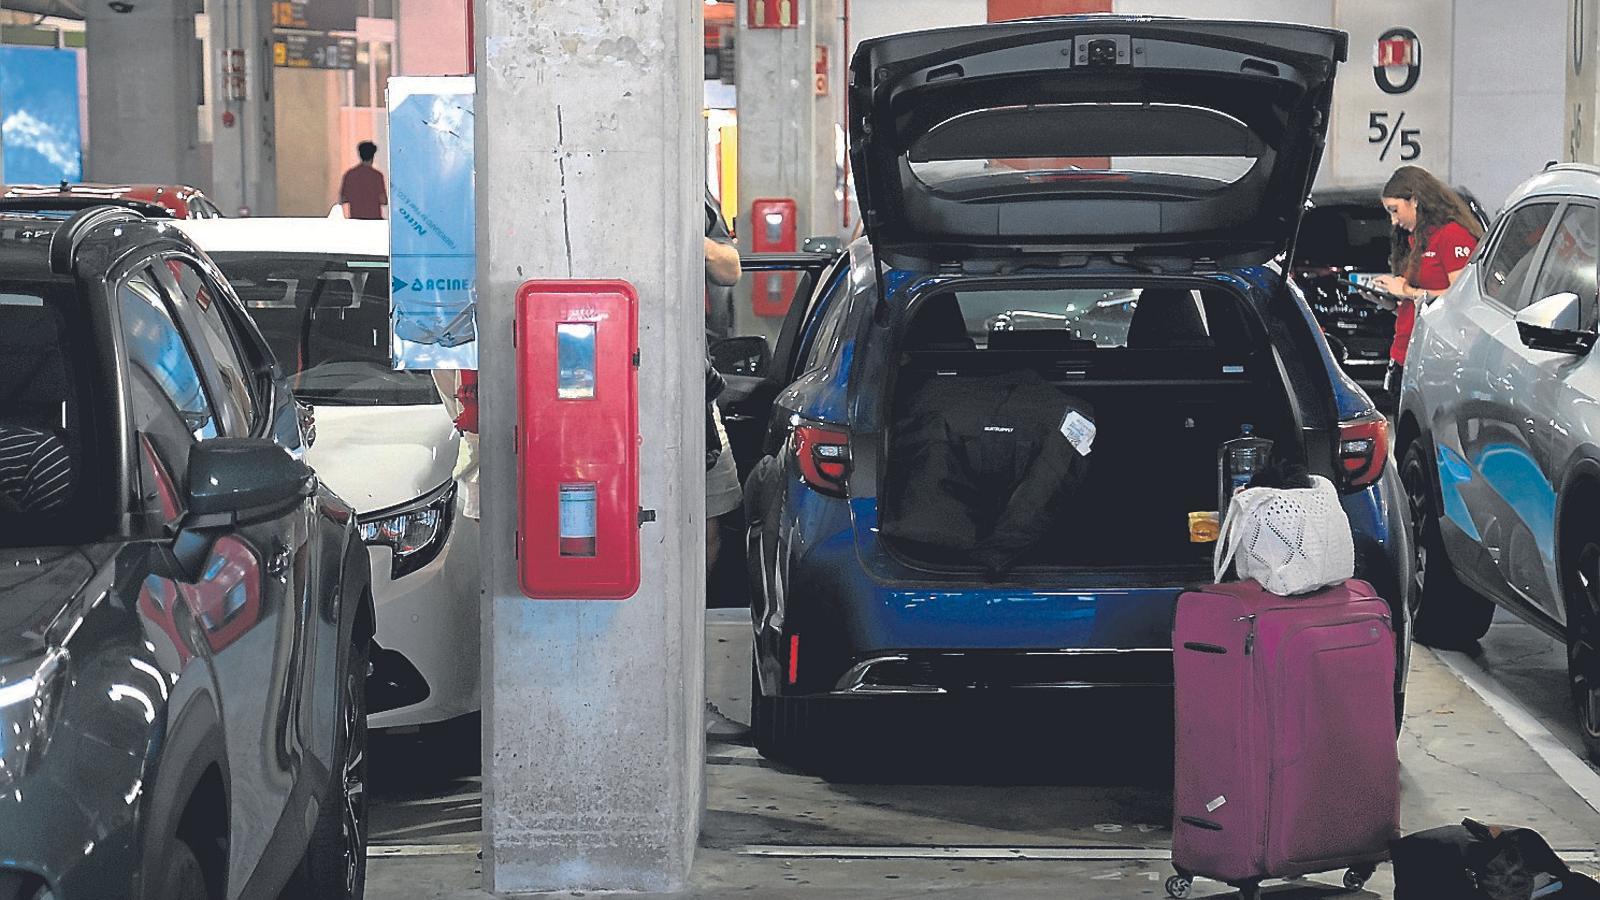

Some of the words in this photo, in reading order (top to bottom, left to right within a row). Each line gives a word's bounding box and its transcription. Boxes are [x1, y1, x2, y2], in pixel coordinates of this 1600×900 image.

[1368, 110, 1421, 161] 5/5
[399, 208, 427, 236] Nitto
[426, 279, 473, 290] ACINE
